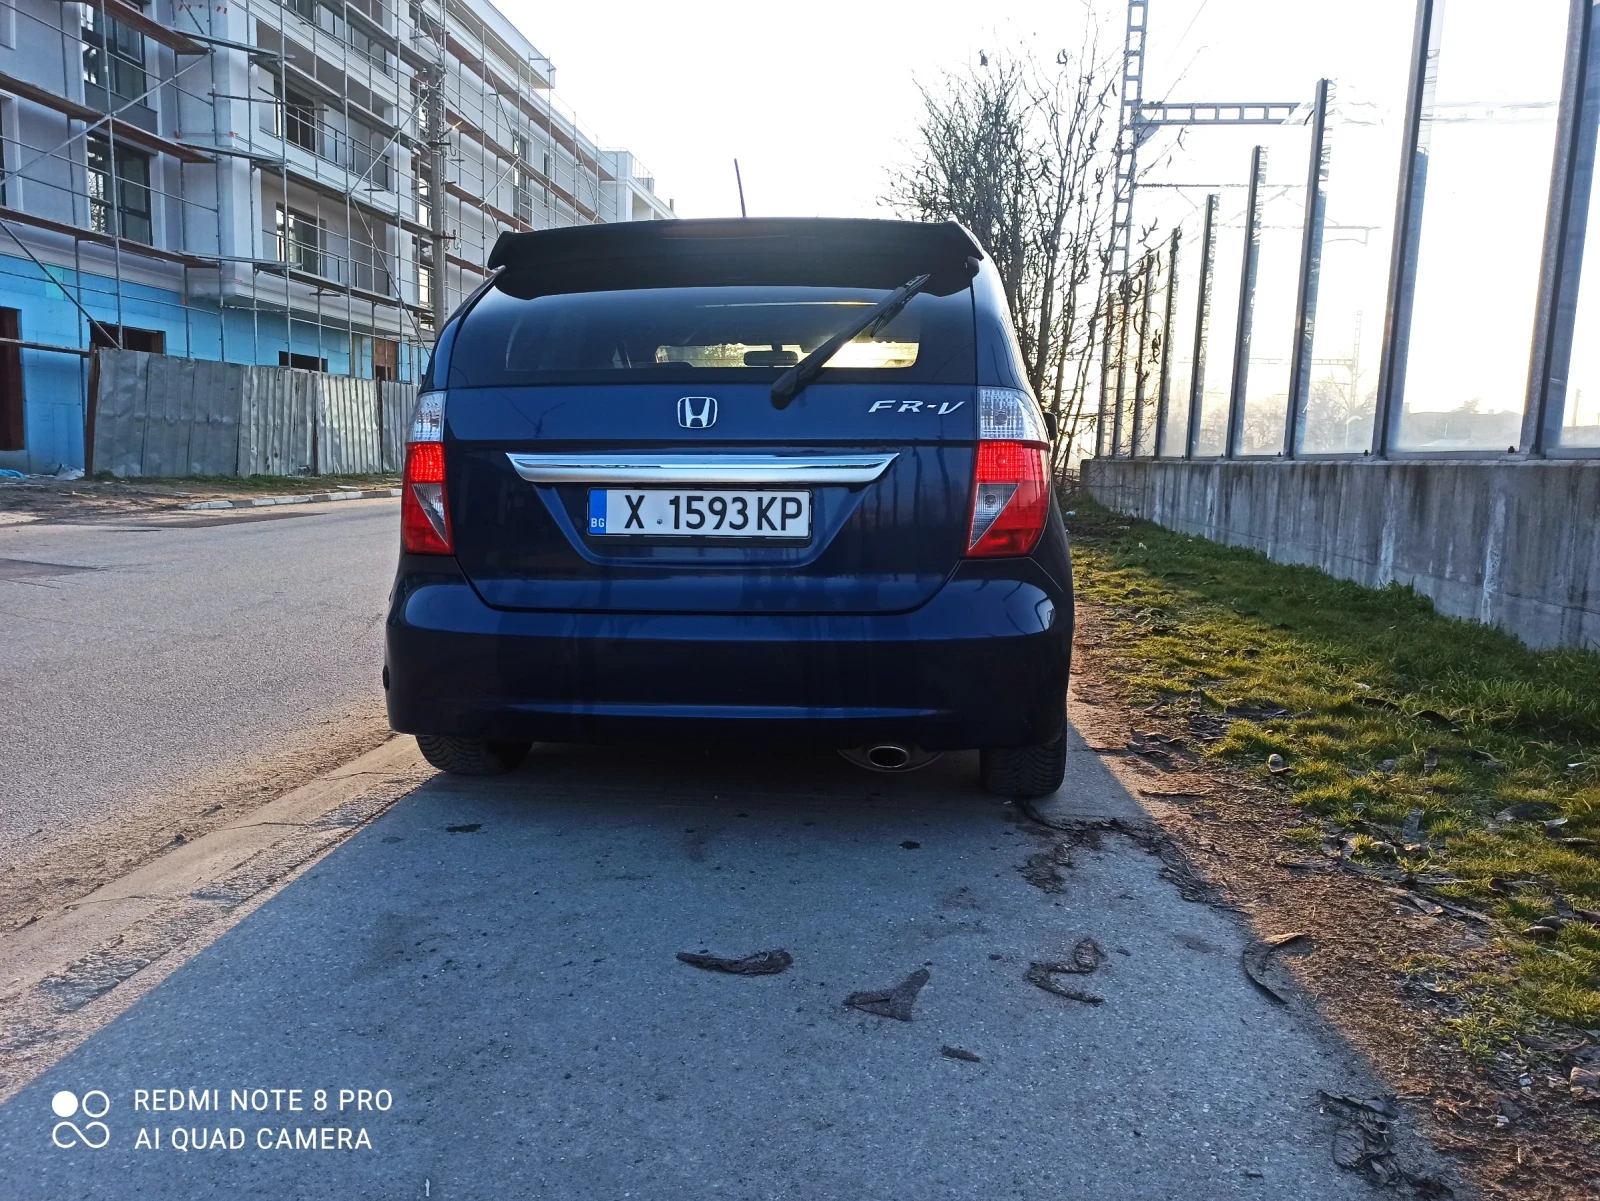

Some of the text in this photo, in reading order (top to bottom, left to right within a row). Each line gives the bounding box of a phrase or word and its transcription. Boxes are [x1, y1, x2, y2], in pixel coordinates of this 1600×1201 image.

[868, 400, 965, 415] FR-V
[624, 495, 803, 531] X 1593 KP
[590, 518, 605, 528] BG
